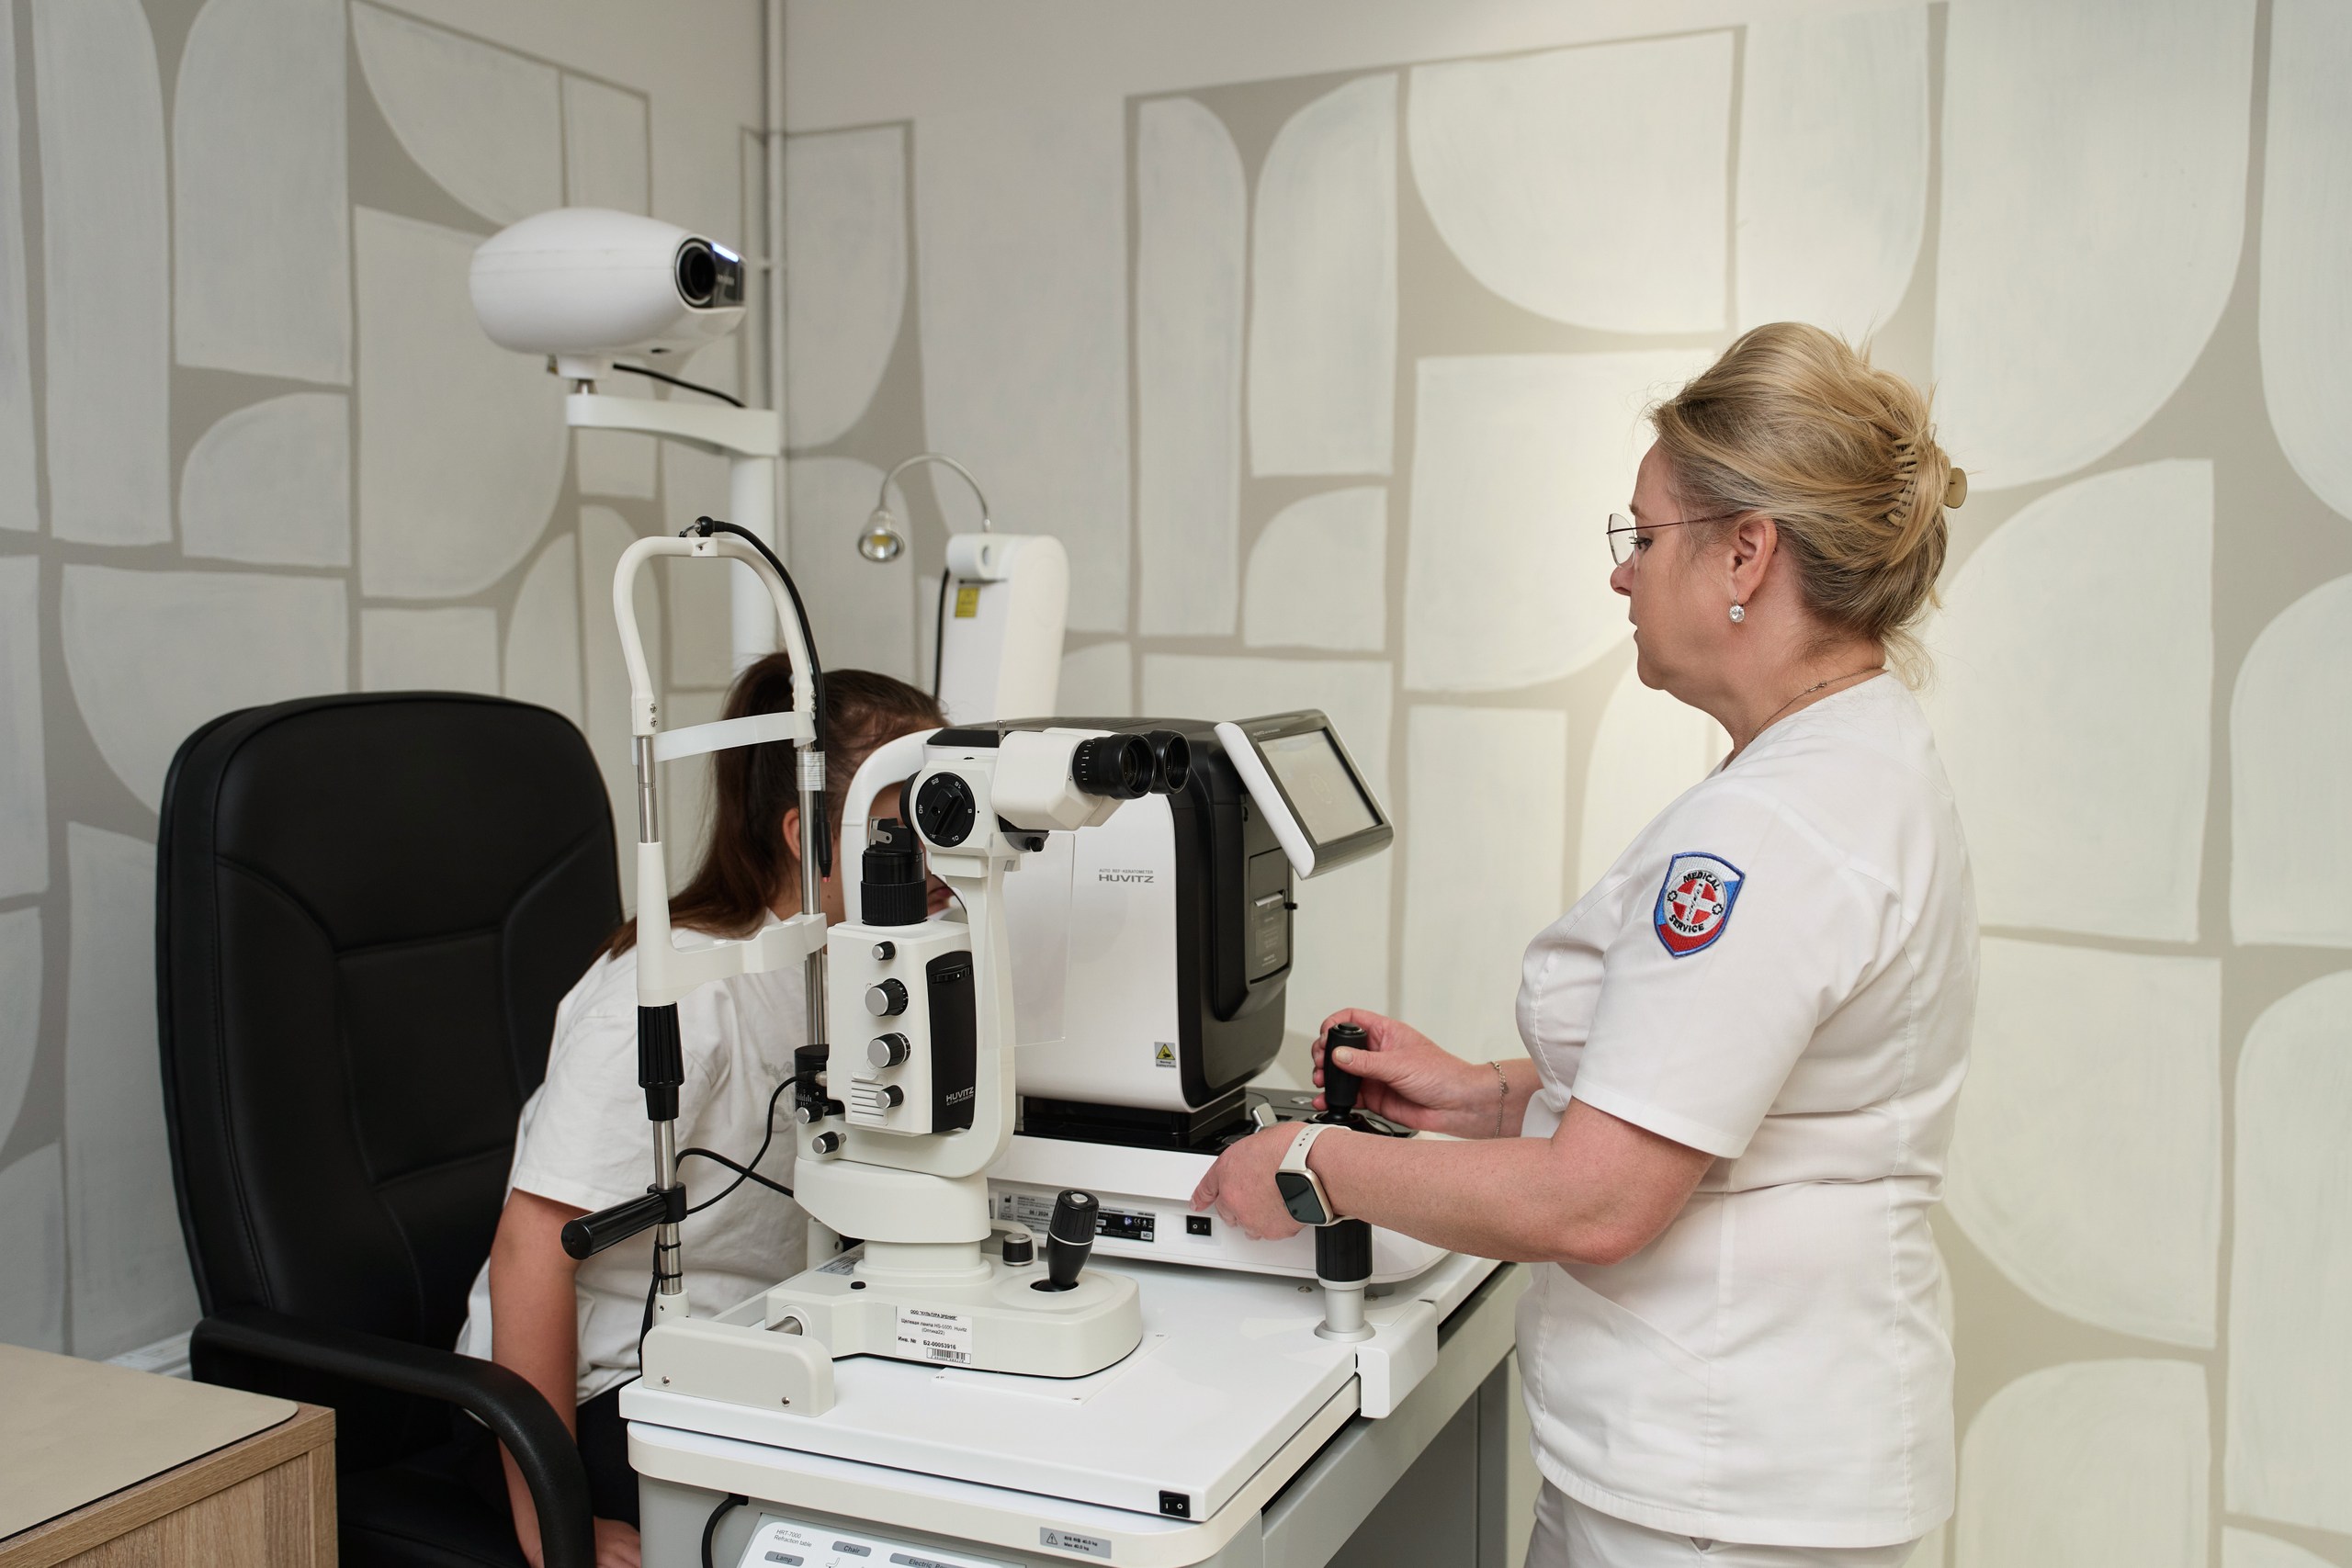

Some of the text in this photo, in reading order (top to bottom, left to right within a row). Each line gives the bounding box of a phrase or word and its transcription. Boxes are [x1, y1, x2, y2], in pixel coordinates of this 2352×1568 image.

[918, 804, 923, 814] 40
[1099, 874, 1154, 883] HUVITZ
[1683, 871, 1721, 891] MEDICAL
[1668, 914, 1704, 932] SERVICE
[945, 1086, 974, 1102] HUVITZ
[776, 1529, 802, 1539] HRT-7000
[774, 1535, 799, 1544] Refraction
[843, 1545, 861, 1554] Chair
[775, 1554, 793, 1563] Lamp
[909, 1558, 933, 1568] Electric
